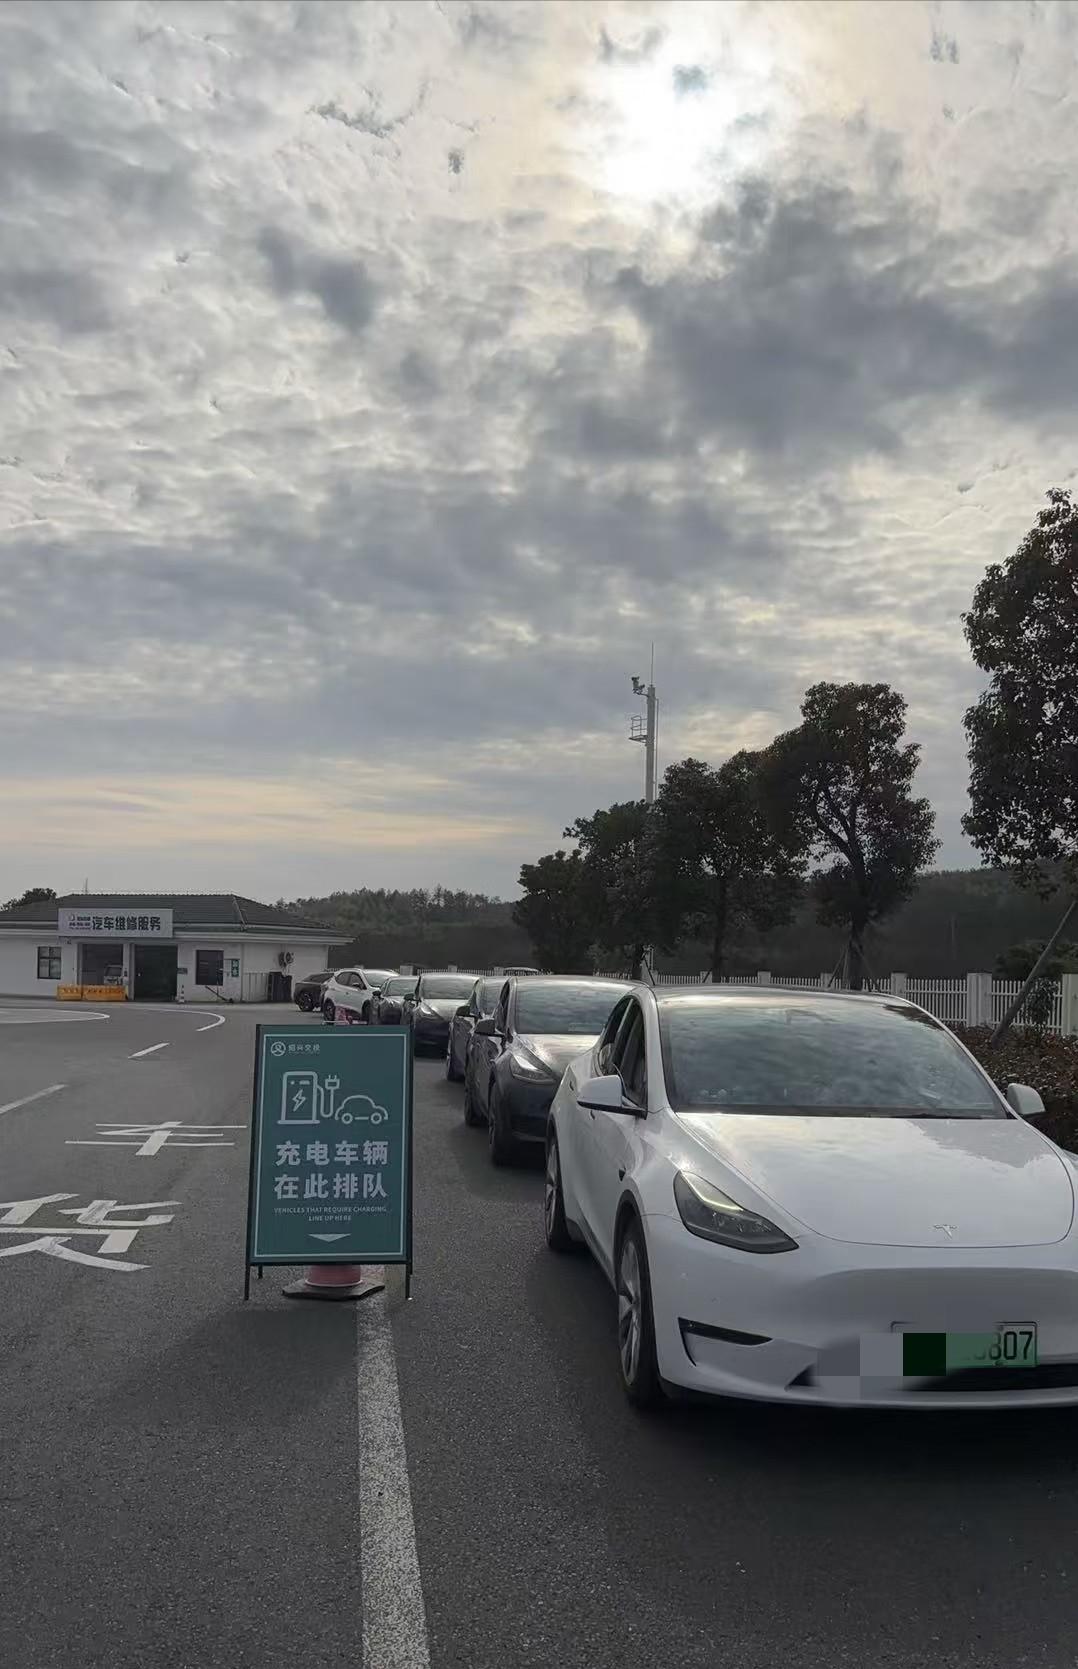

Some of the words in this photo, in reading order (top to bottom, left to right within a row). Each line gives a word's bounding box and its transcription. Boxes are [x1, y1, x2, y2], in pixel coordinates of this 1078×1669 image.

[92, 916, 160, 931] 汽车维修服务
[275, 1140, 389, 1166] 充电车辆
[274, 1172, 389, 1200] 在此排队
